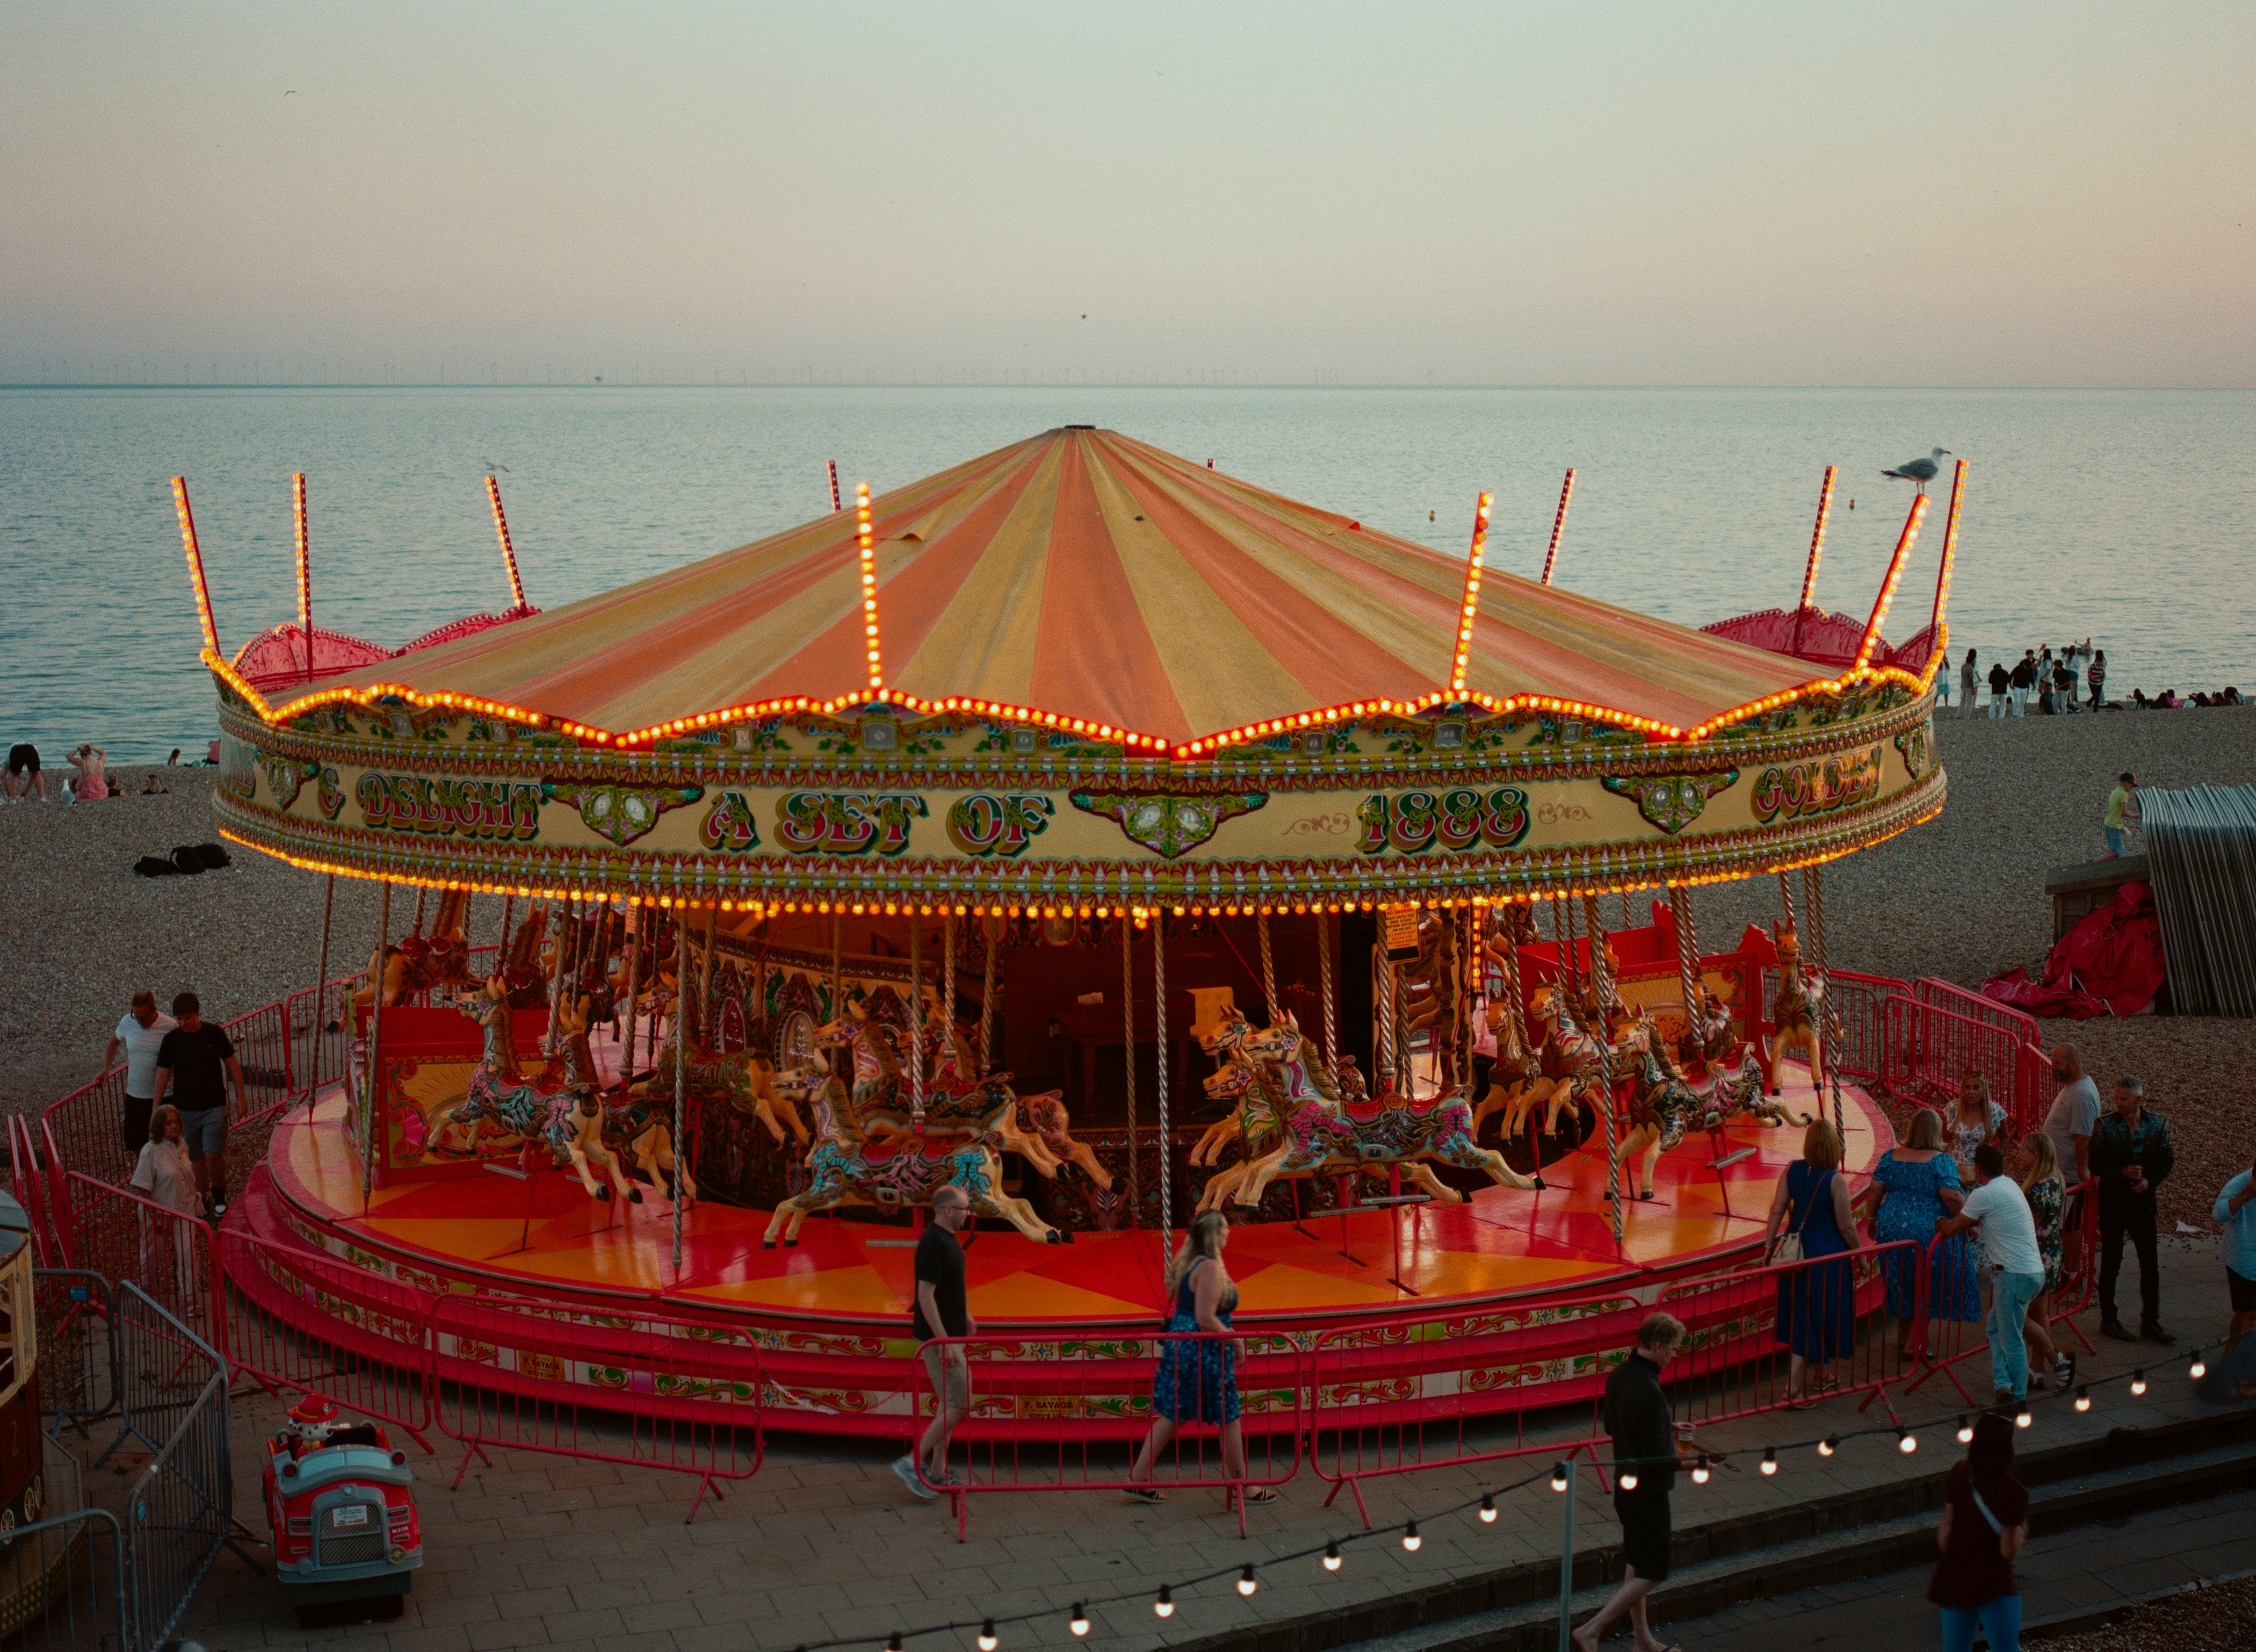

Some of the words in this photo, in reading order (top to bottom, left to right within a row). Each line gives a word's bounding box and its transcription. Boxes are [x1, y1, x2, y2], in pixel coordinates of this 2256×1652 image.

[318, 765, 346, 820] &
[356, 771, 546, 840] DELIGHT
[1751, 744, 1883, 823] GOLDEN
[699, 790, 761, 850] A
[774, 791, 930, 855] SET
[946, 791, 1056, 857] OF
[1354, 786, 1530, 854] 1888
